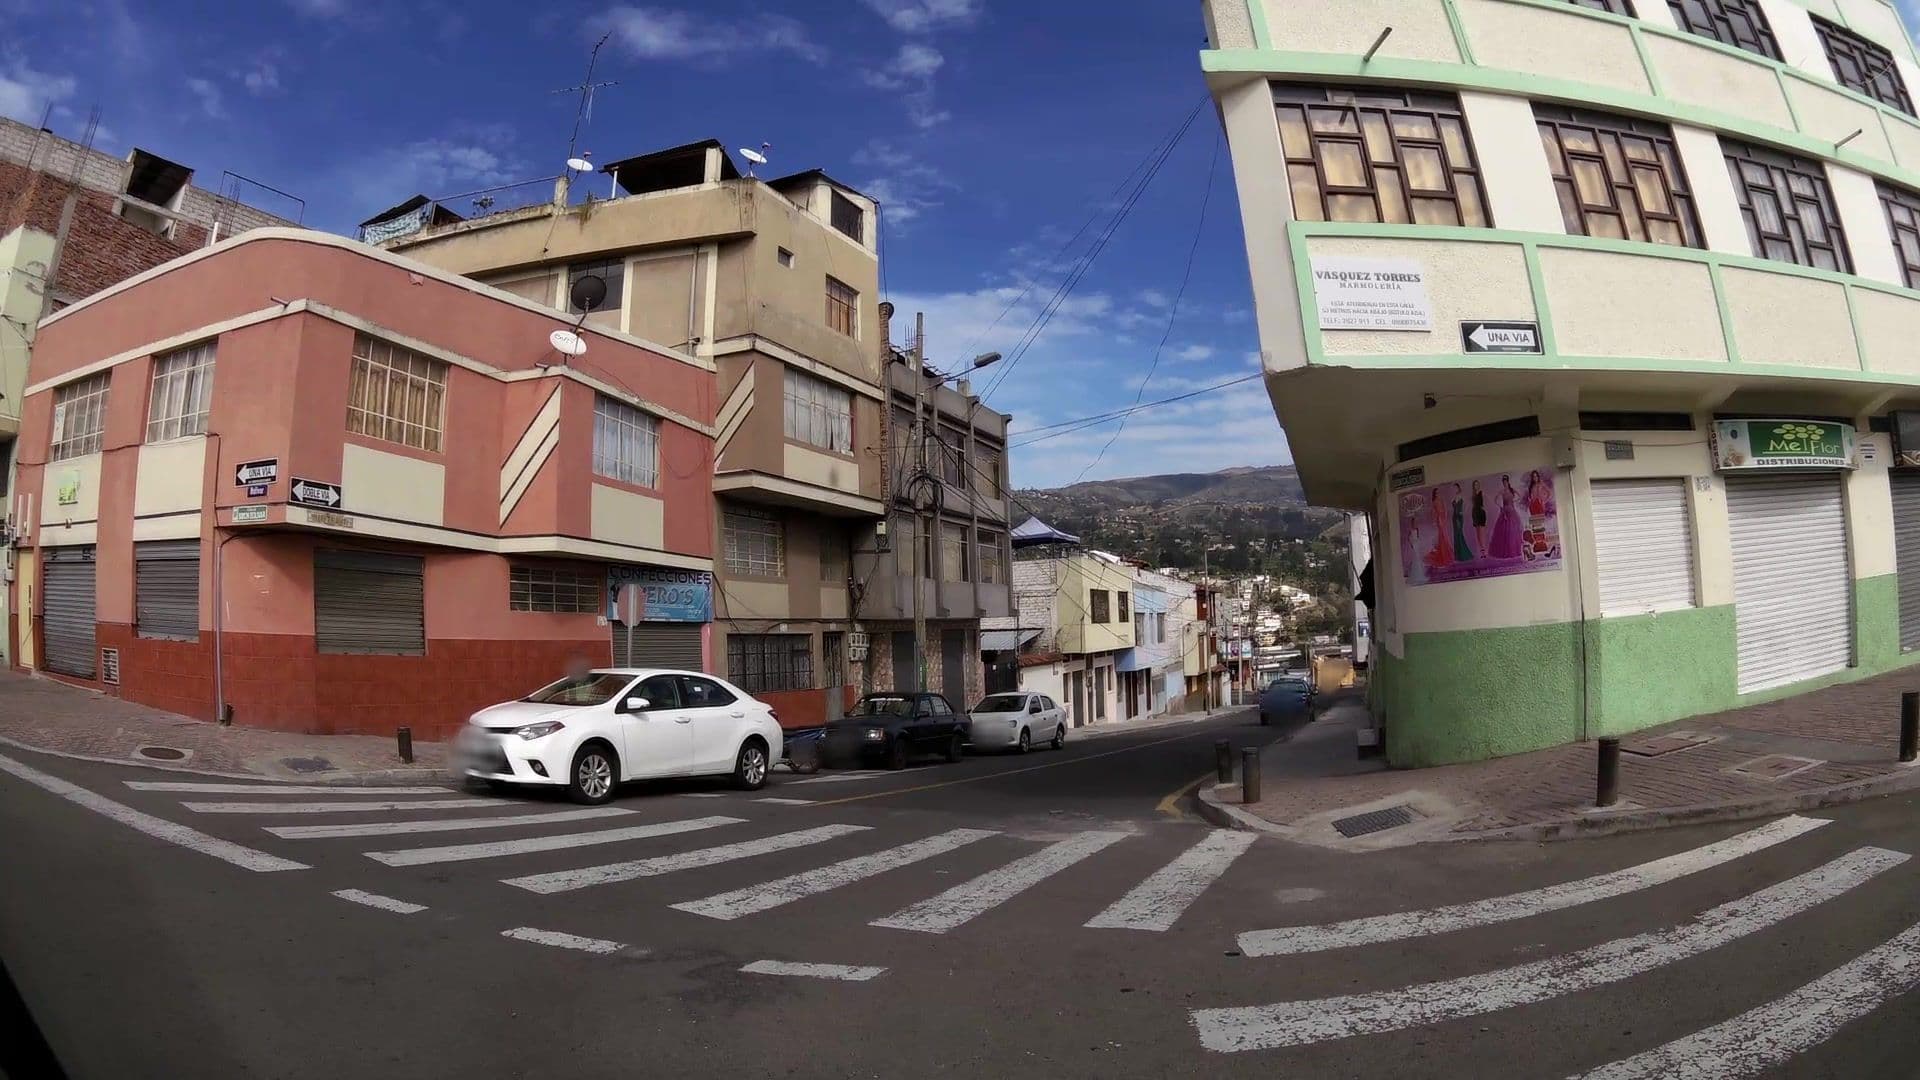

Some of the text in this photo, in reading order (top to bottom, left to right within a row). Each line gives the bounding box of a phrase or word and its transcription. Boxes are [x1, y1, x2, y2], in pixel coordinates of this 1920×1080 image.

[1374, 272, 1421, 283] TORRES
[1488, 332, 1530, 343] UNA VIA
[1756, 458, 1845, 466] DISTRIBUCIONES
[248, 467, 272, 478] UNA VIA
[303, 487, 329, 500] DOBLE VIA
[609, 566, 711, 584] CONFECCIONES
